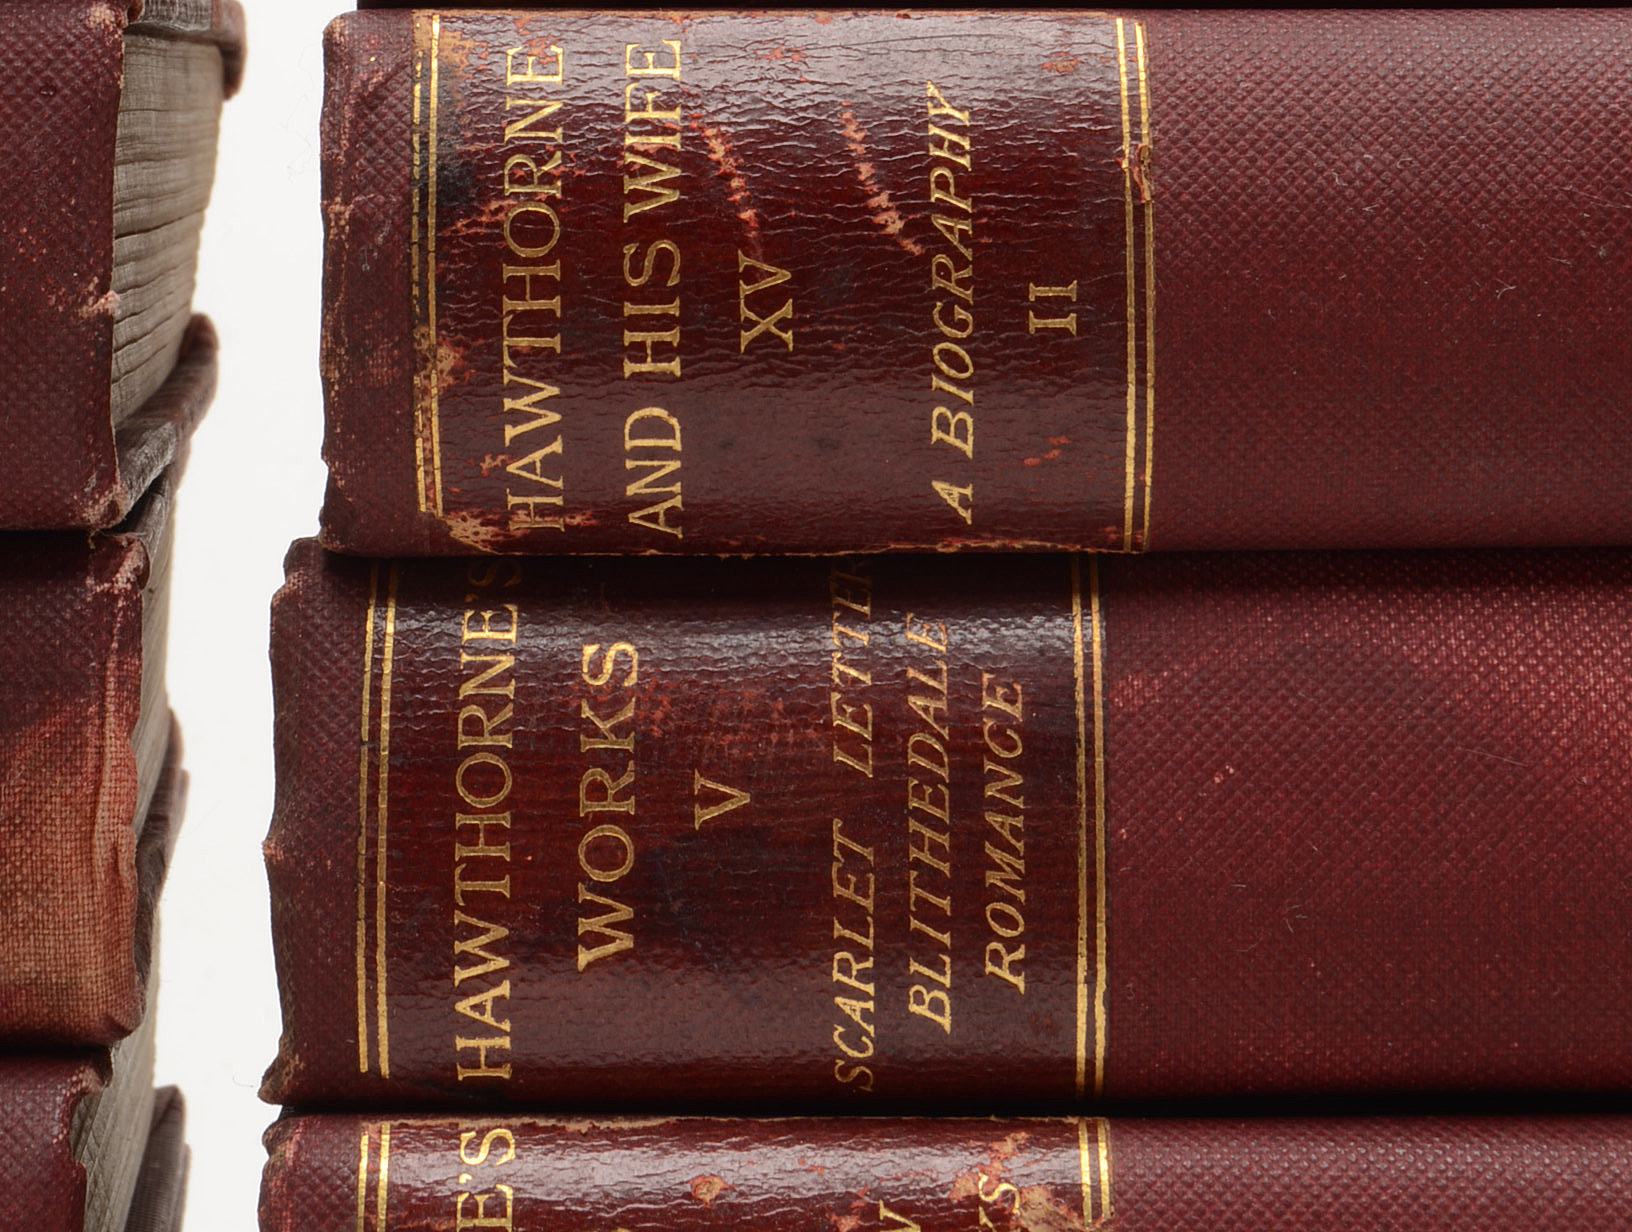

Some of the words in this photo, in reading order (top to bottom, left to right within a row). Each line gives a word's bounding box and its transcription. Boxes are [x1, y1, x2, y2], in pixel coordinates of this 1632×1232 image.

[623, 38, 683, 223] WIFE
[503, 44, 565, 533] HAWTHORNE
[623, 240, 683, 380] HIS
[738, 249, 795, 353] XV
[926, 81, 975, 458] BIOGRAPHY
[1029, 278, 1079, 336] II
[625, 405, 684, 540] AND
[929, 481, 974, 526] A
[454, 555, 523, 1082] HAWTHORNE'S
[578, 640, 639, 972] WORKS
[694, 769, 752, 831] V
[907, 611, 953, 1036] BLITHEDALE
[981, 672, 1026, 995] ROMANCE
[832, 818, 875, 1095] SCARLET
